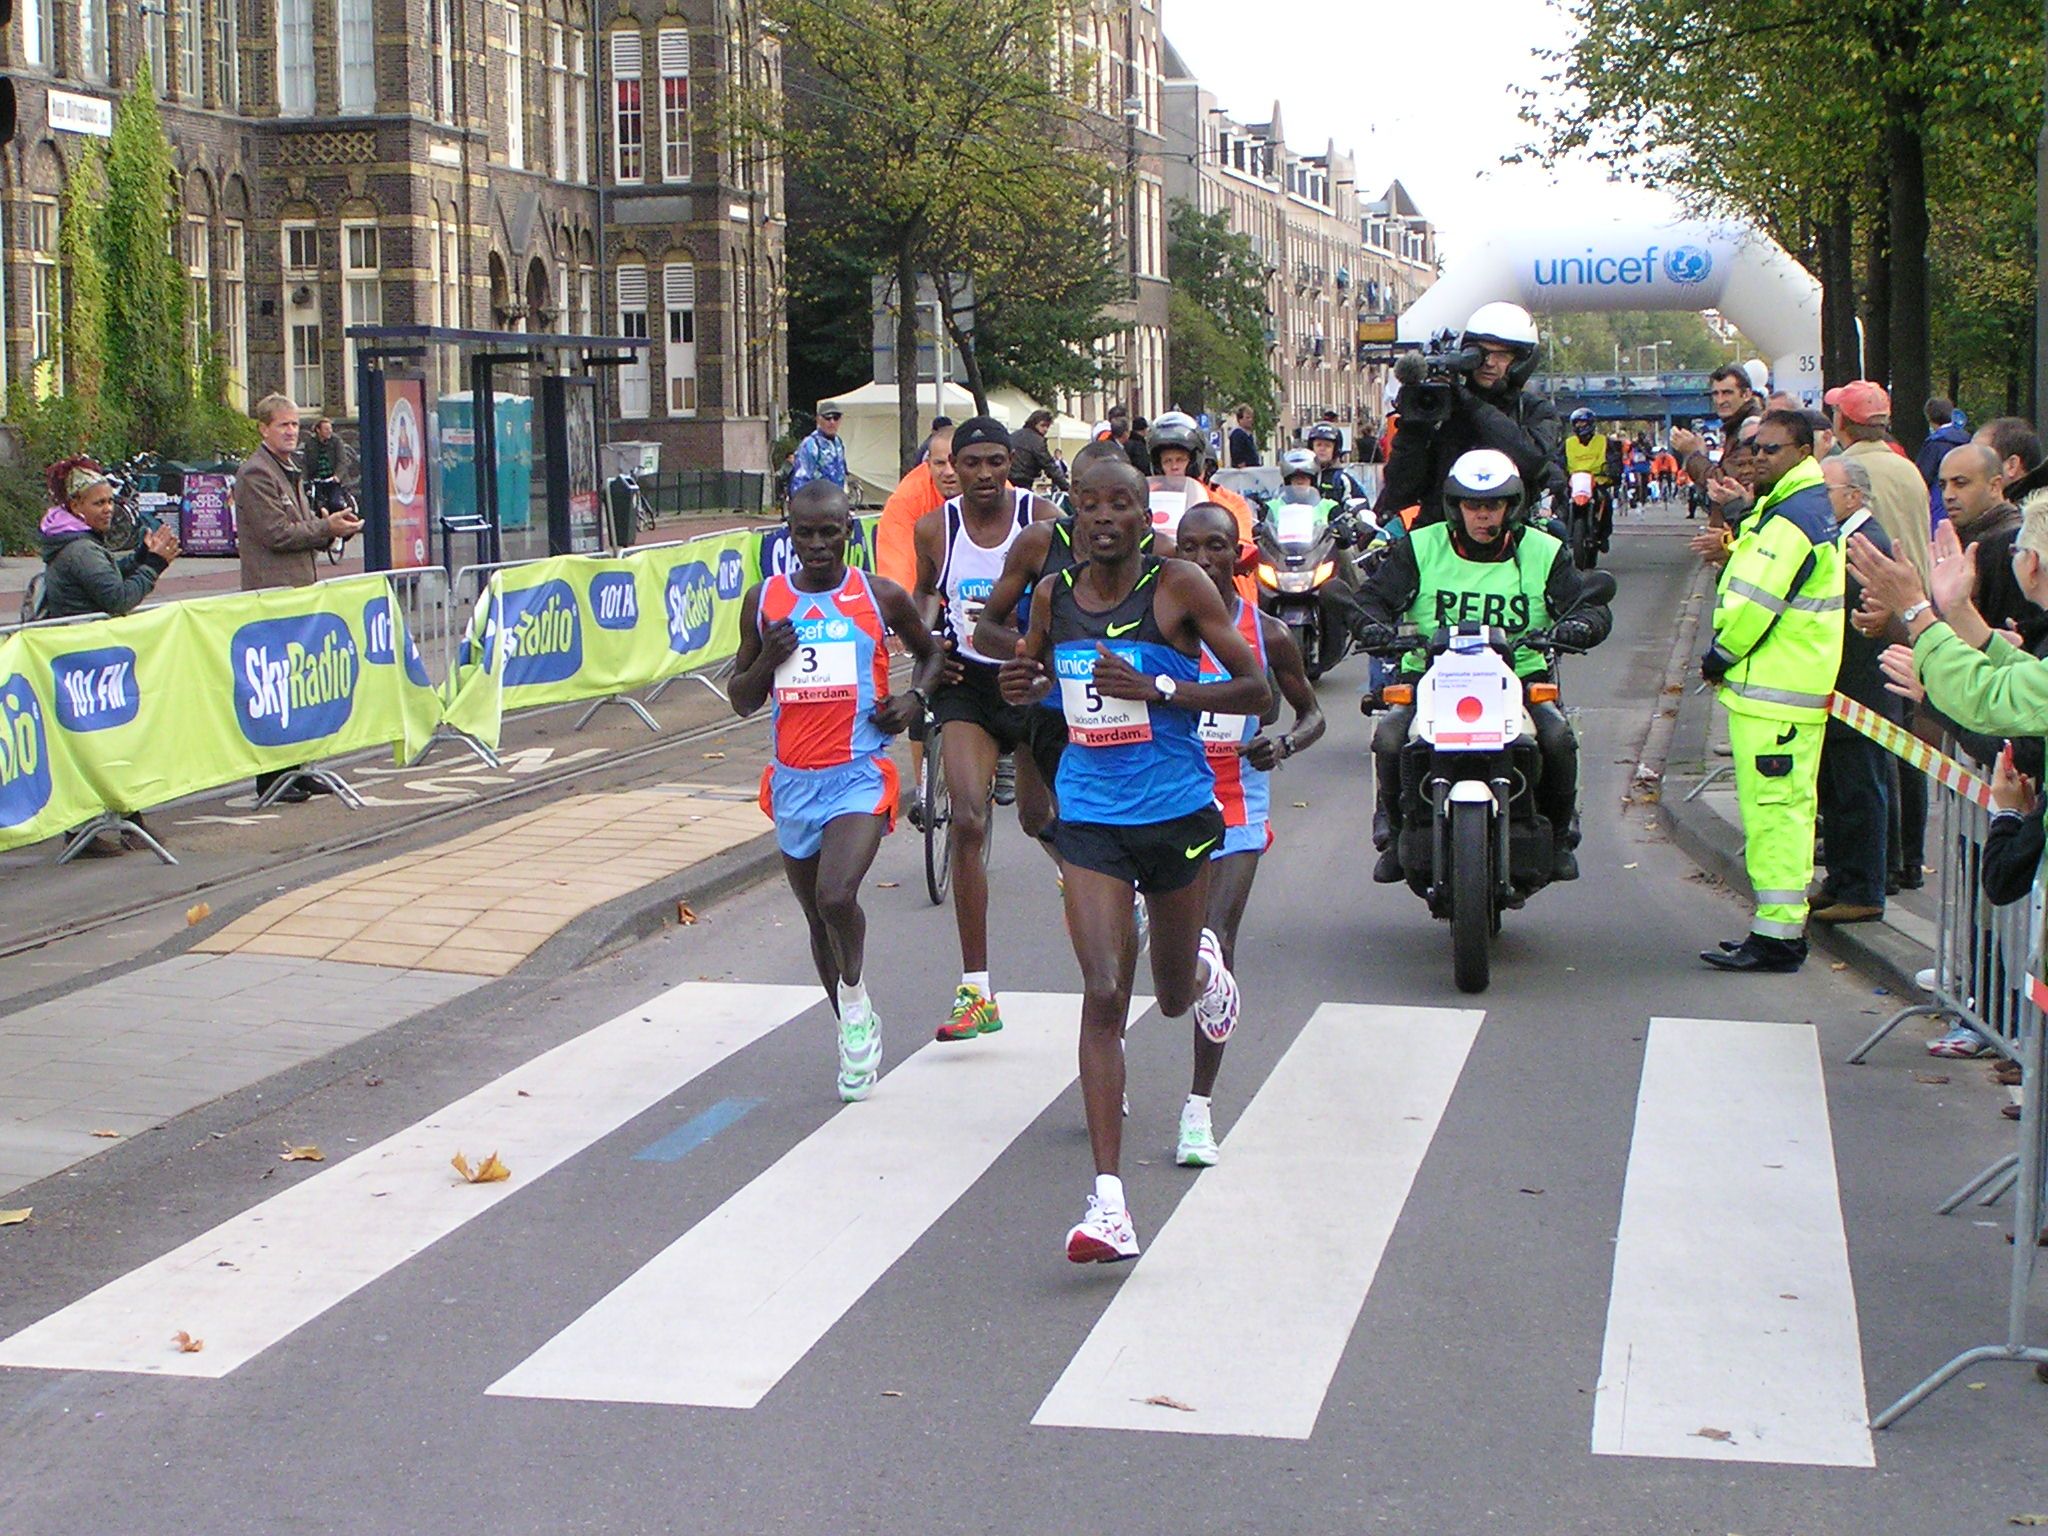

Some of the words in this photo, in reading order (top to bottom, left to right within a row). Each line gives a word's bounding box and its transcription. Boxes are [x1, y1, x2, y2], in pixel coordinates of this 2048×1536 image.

[1535, 246, 1658, 286] unicef
[1799, 355, 1816, 372] 35
[600, 584, 622, 619] 101
[1434, 588, 1530, 633] PERS
[794, 620, 825, 641] cef
[801, 647, 818, 673] 3
[64, 669, 96, 717] 101
[98, 661, 129, 709] FM
[792, 674, 810, 684] Paul
[1085, 683, 1103, 713] 5
[1101, 712, 1130, 724] Koech
